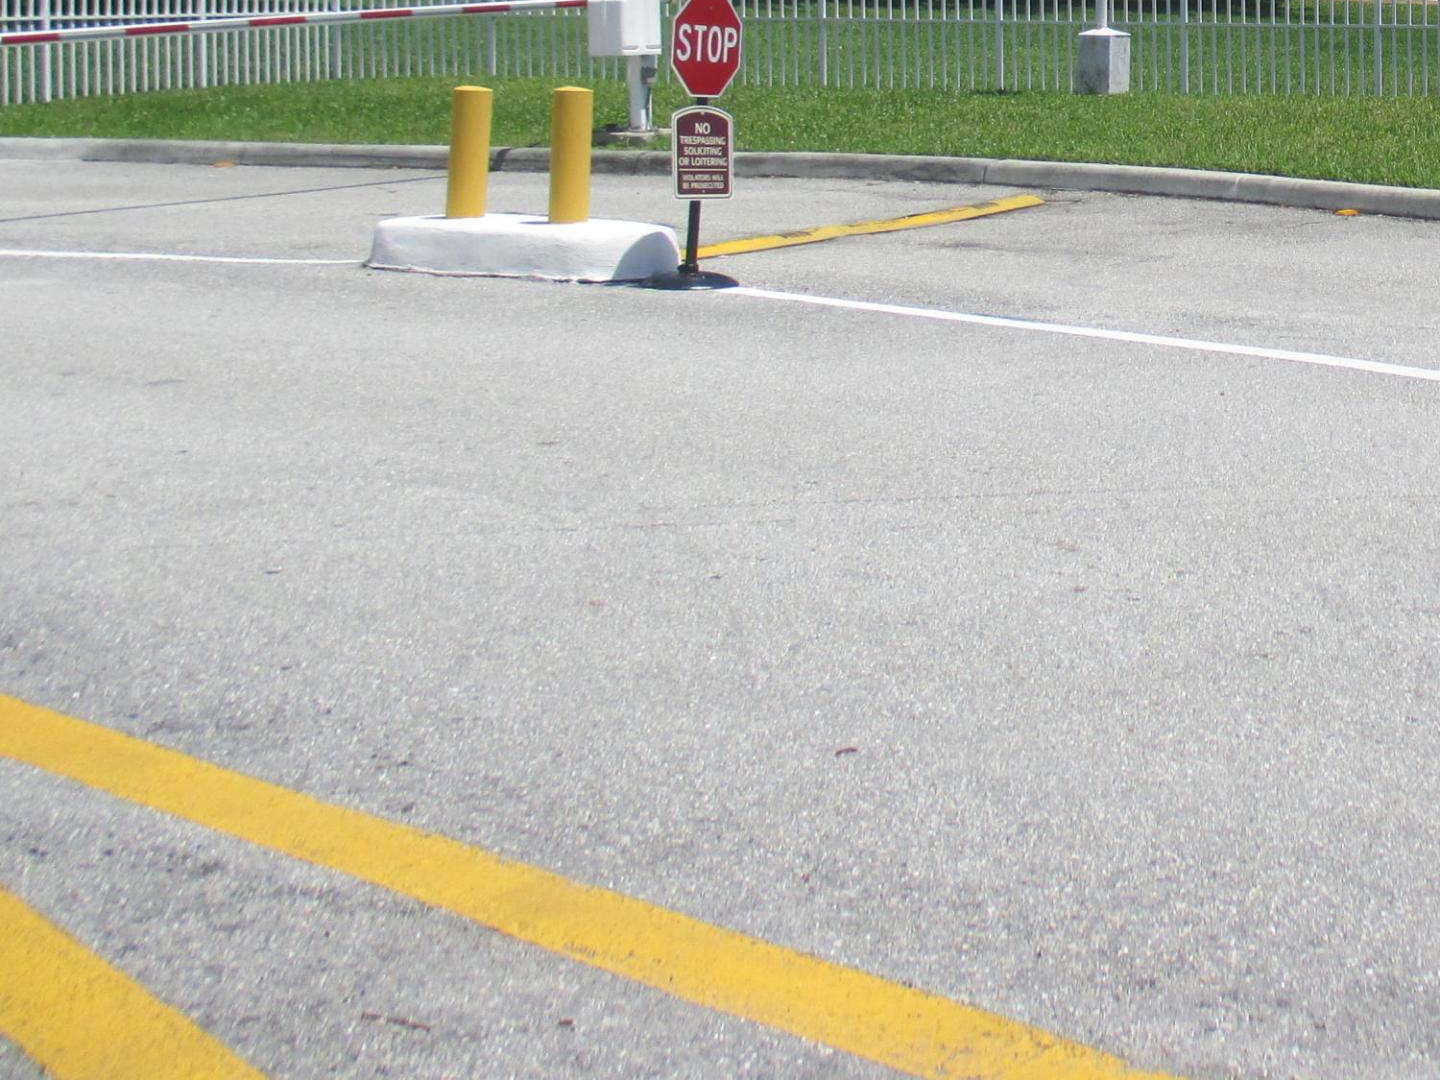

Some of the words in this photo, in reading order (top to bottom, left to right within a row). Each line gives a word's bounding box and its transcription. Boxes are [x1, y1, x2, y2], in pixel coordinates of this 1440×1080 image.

[676, 23, 738, 64] STOP
[695, 122, 711, 134] NO
[680, 135, 726, 145] TRESPASSING
[683, 146, 722, 156] SOLICITING
[678, 157, 690, 166] OR
[691, 157, 728, 166] LOITERING
